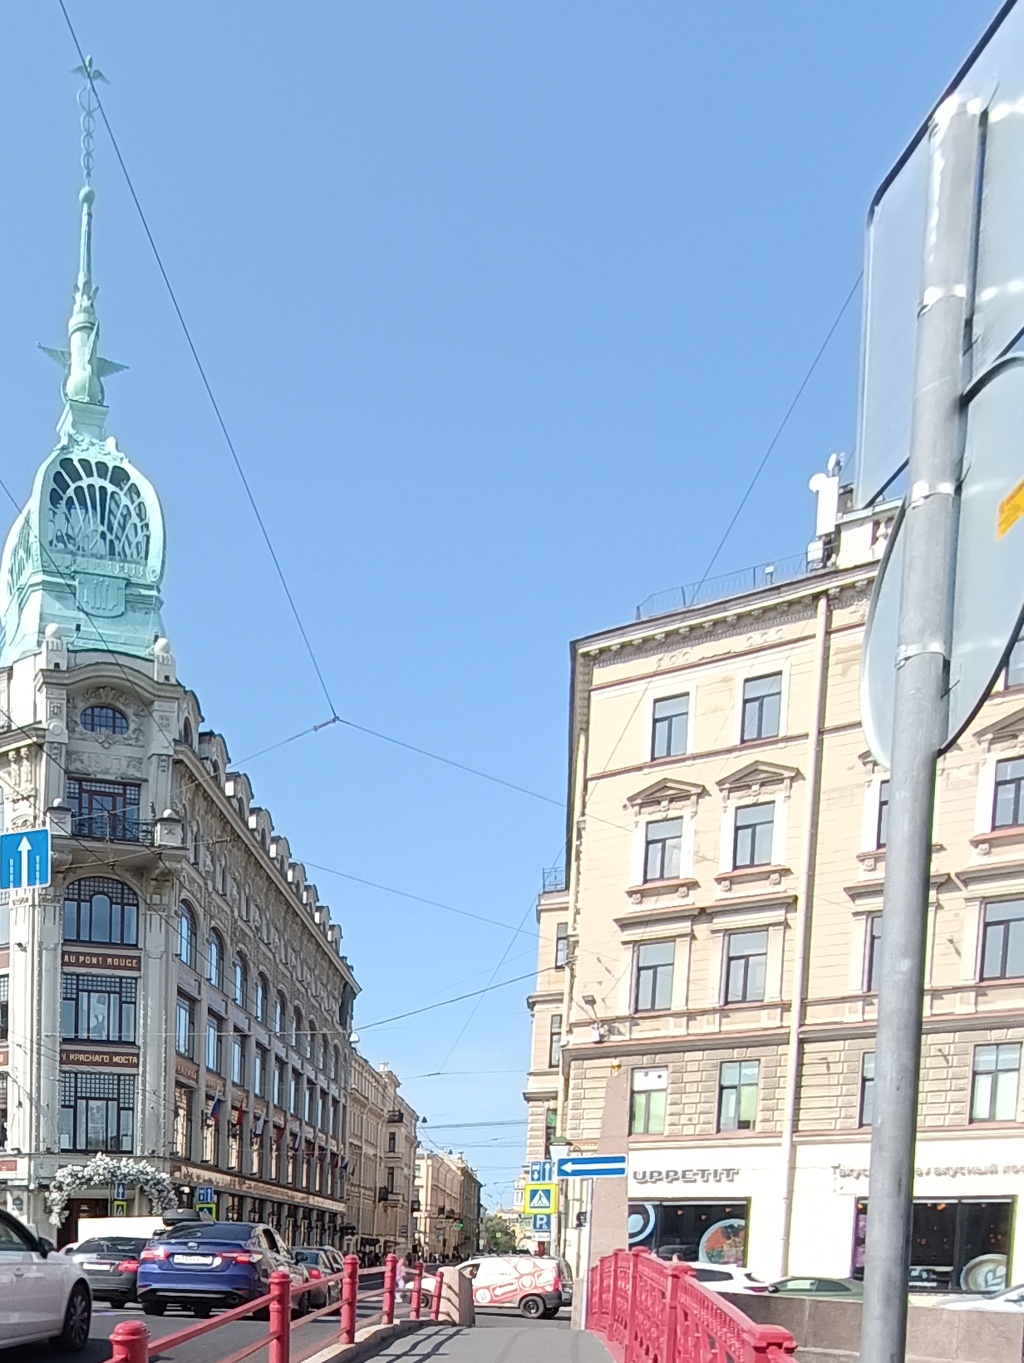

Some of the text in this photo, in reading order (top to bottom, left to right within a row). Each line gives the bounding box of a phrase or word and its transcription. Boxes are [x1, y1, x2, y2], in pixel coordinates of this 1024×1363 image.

[63, 954, 138, 968] AU PONT ROUGE
[61, 1053, 138, 1064] У КРАСНАГО МОСТА
[632, 1168, 740, 1185] UPPETIT
